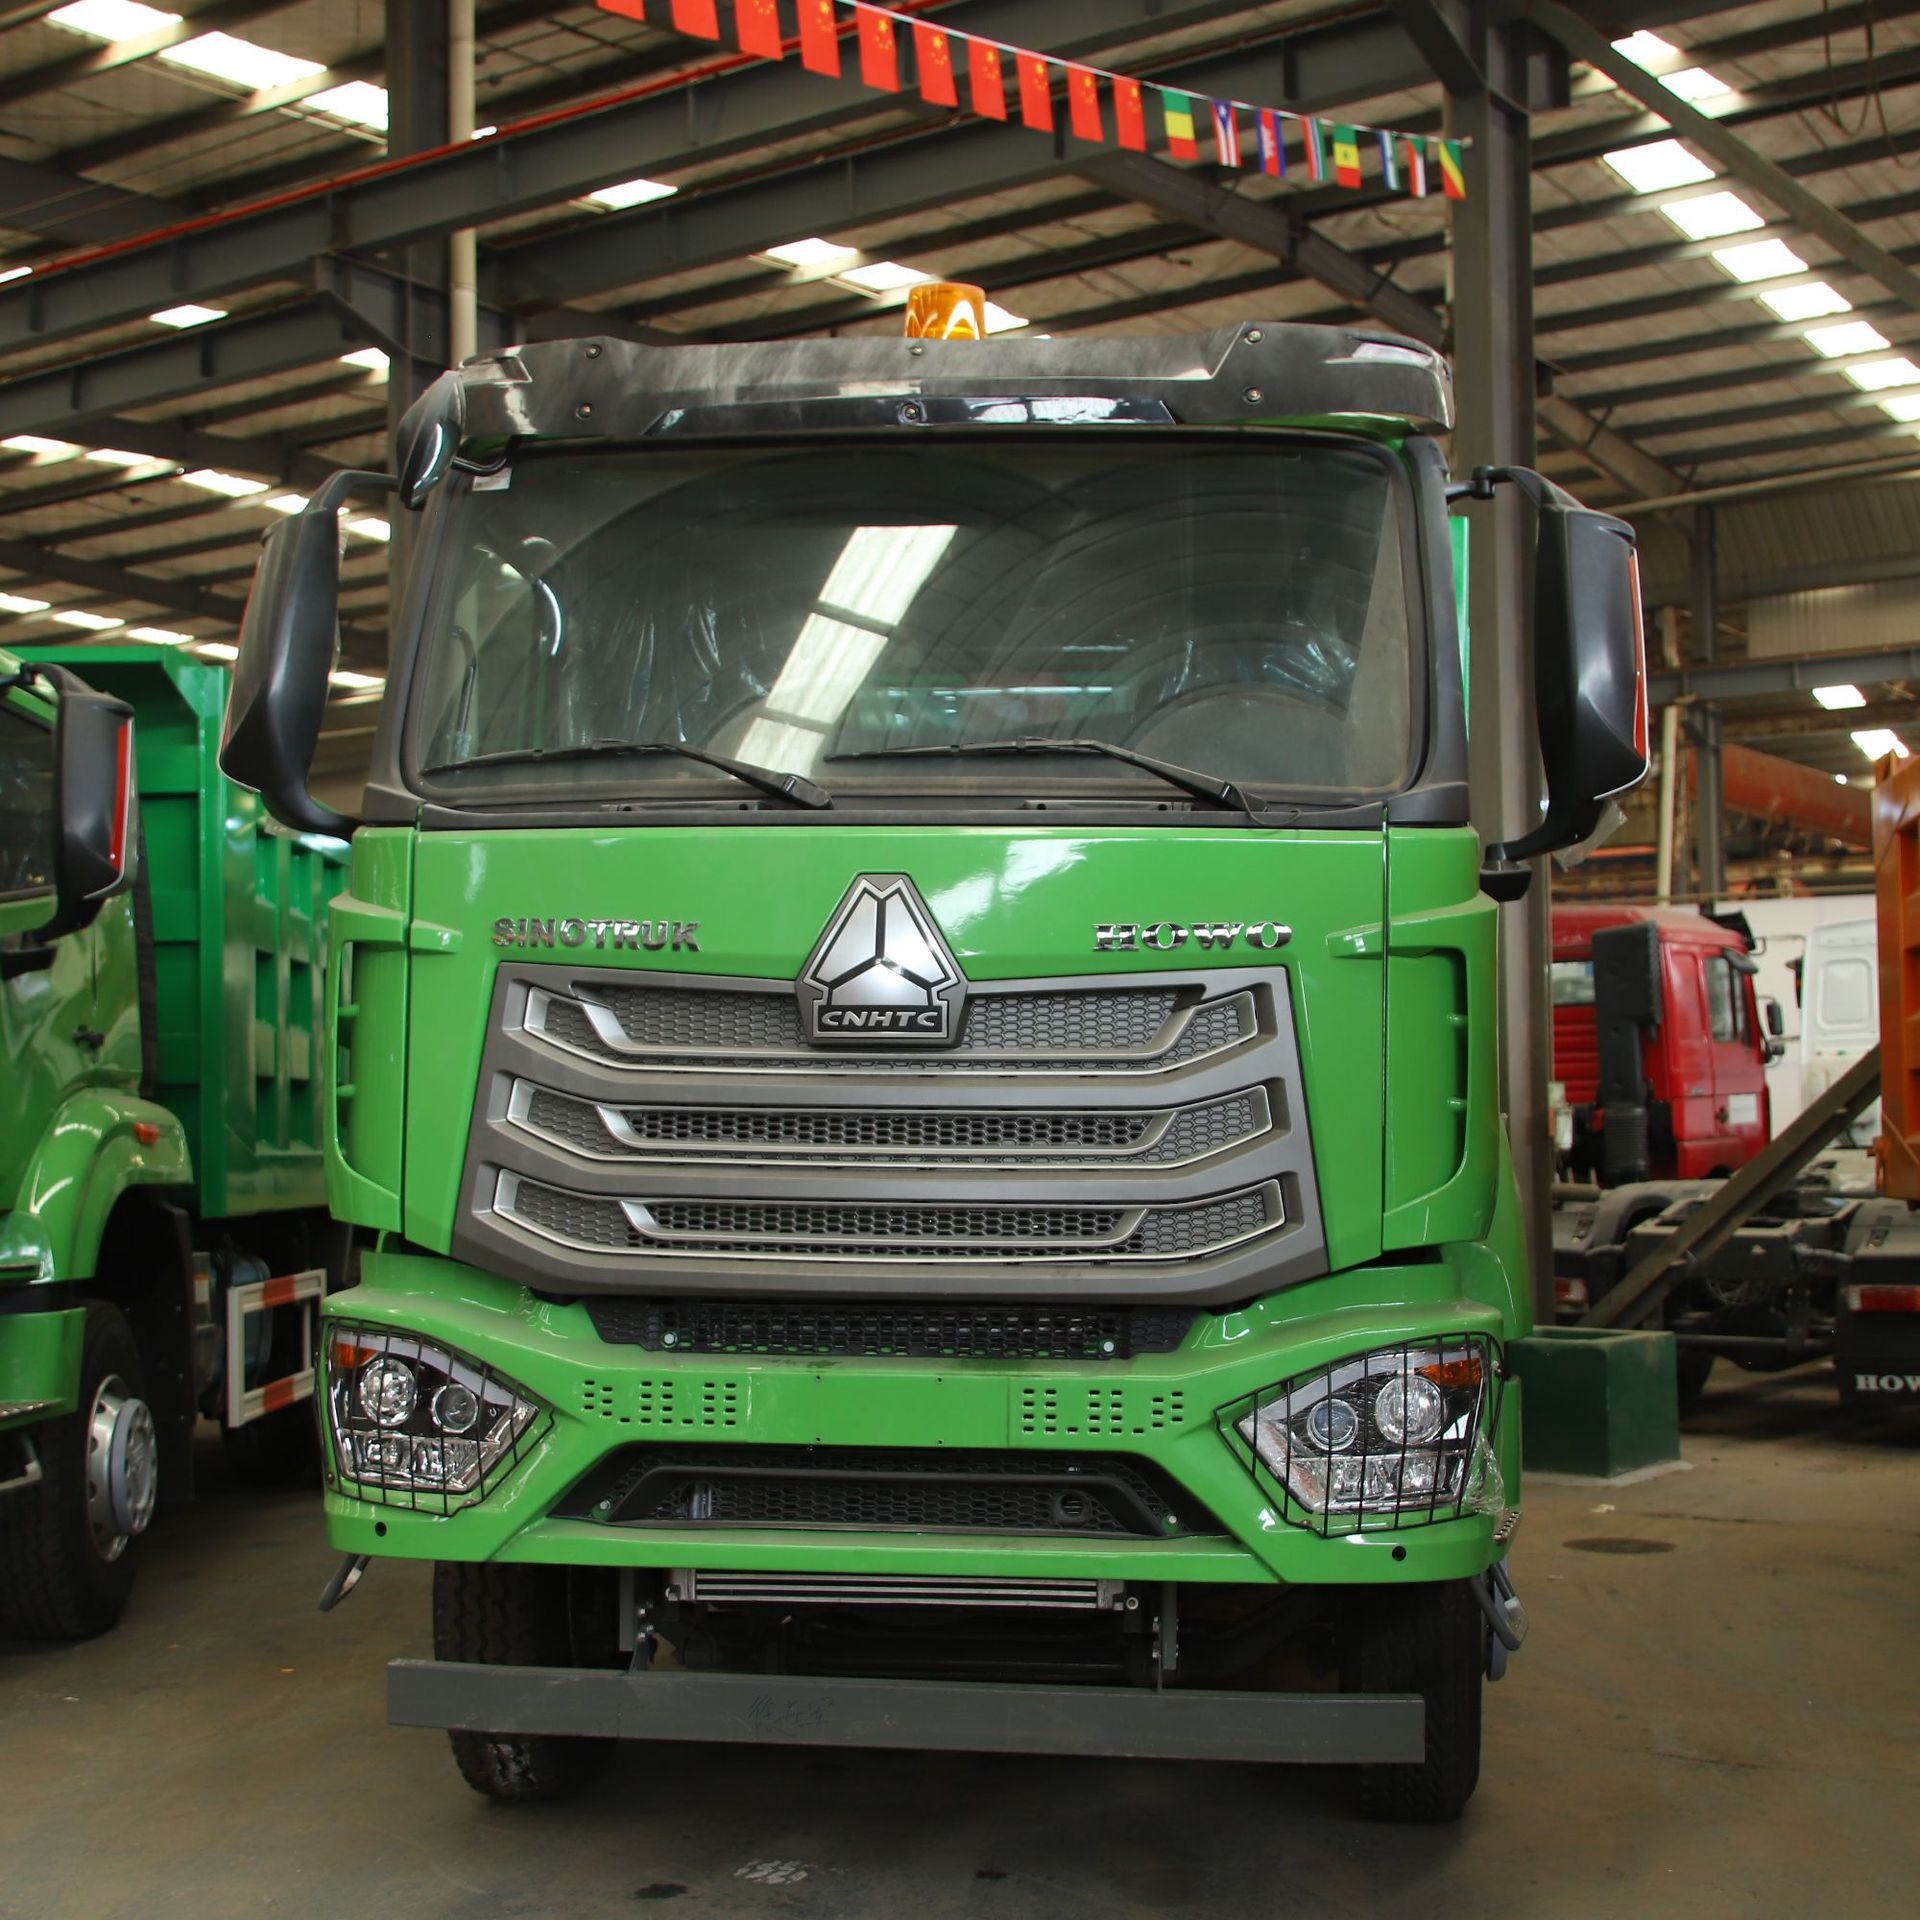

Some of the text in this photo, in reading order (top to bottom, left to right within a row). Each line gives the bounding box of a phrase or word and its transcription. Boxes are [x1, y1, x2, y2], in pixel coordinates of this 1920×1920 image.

[493, 917, 700, 951] SINOTRUK
[1092, 921, 1292, 951] HOWO
[821, 1010, 938, 1027] CNHTC
